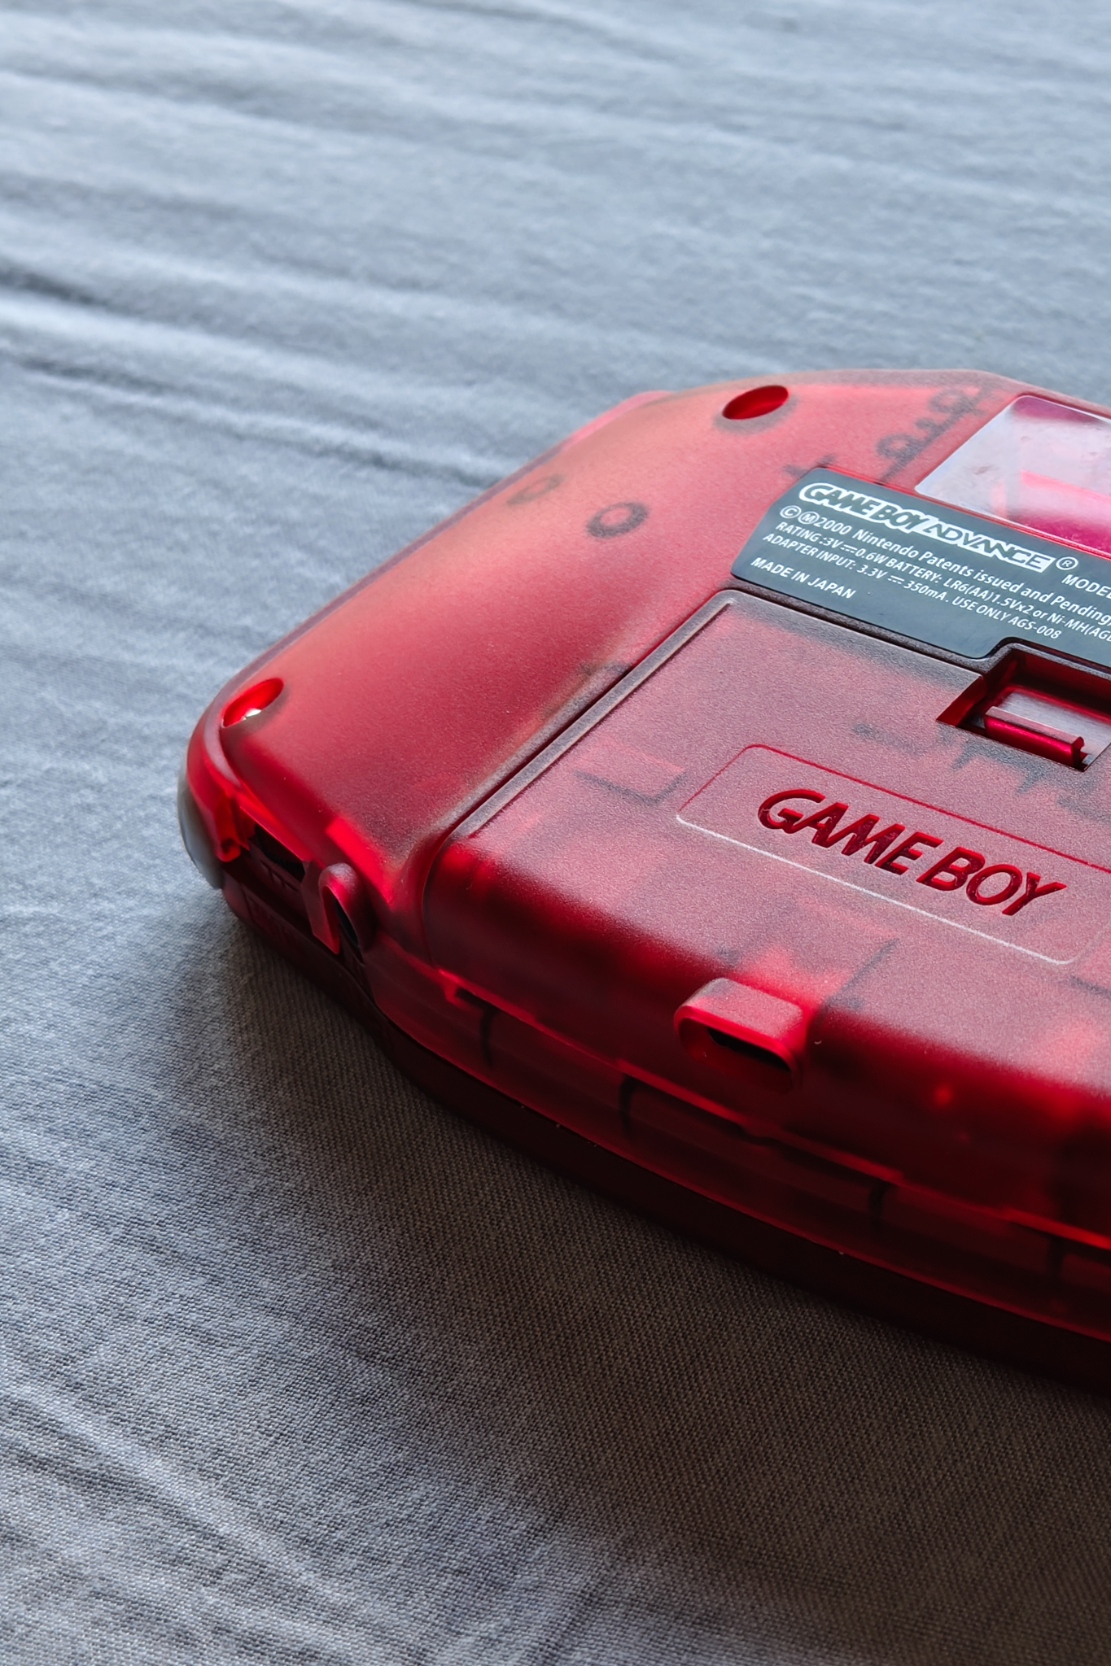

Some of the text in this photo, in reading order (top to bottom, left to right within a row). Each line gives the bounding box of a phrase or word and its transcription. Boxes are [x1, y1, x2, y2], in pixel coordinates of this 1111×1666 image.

[799, 483, 877, 520] GAME
[871, 501, 932, 534] BOY
[924, 521, 1056, 573] ADVANCE
[852, 529, 918, 558] Nintendo
[918, 551, 974, 577] Patents
[973, 570, 1024, 593] issued
[1021, 586, 1055, 603] and
[750, 557, 857, 599] MADE IN JAPAN
[763, 533, 818, 557] ADAPTER
[816, 549, 856, 570] INPUT:
[857, 565, 888, 580] 3.3V
[951, 596, 978, 611] USE
[976, 603, 1011, 622] ONLY
[1008, 615, 1062, 640] AGS-008
[885, 557, 943, 584] BATTERY:
[1032, 610, 1048, 619] or
[757, 788, 1067, 916] GAME BOY
